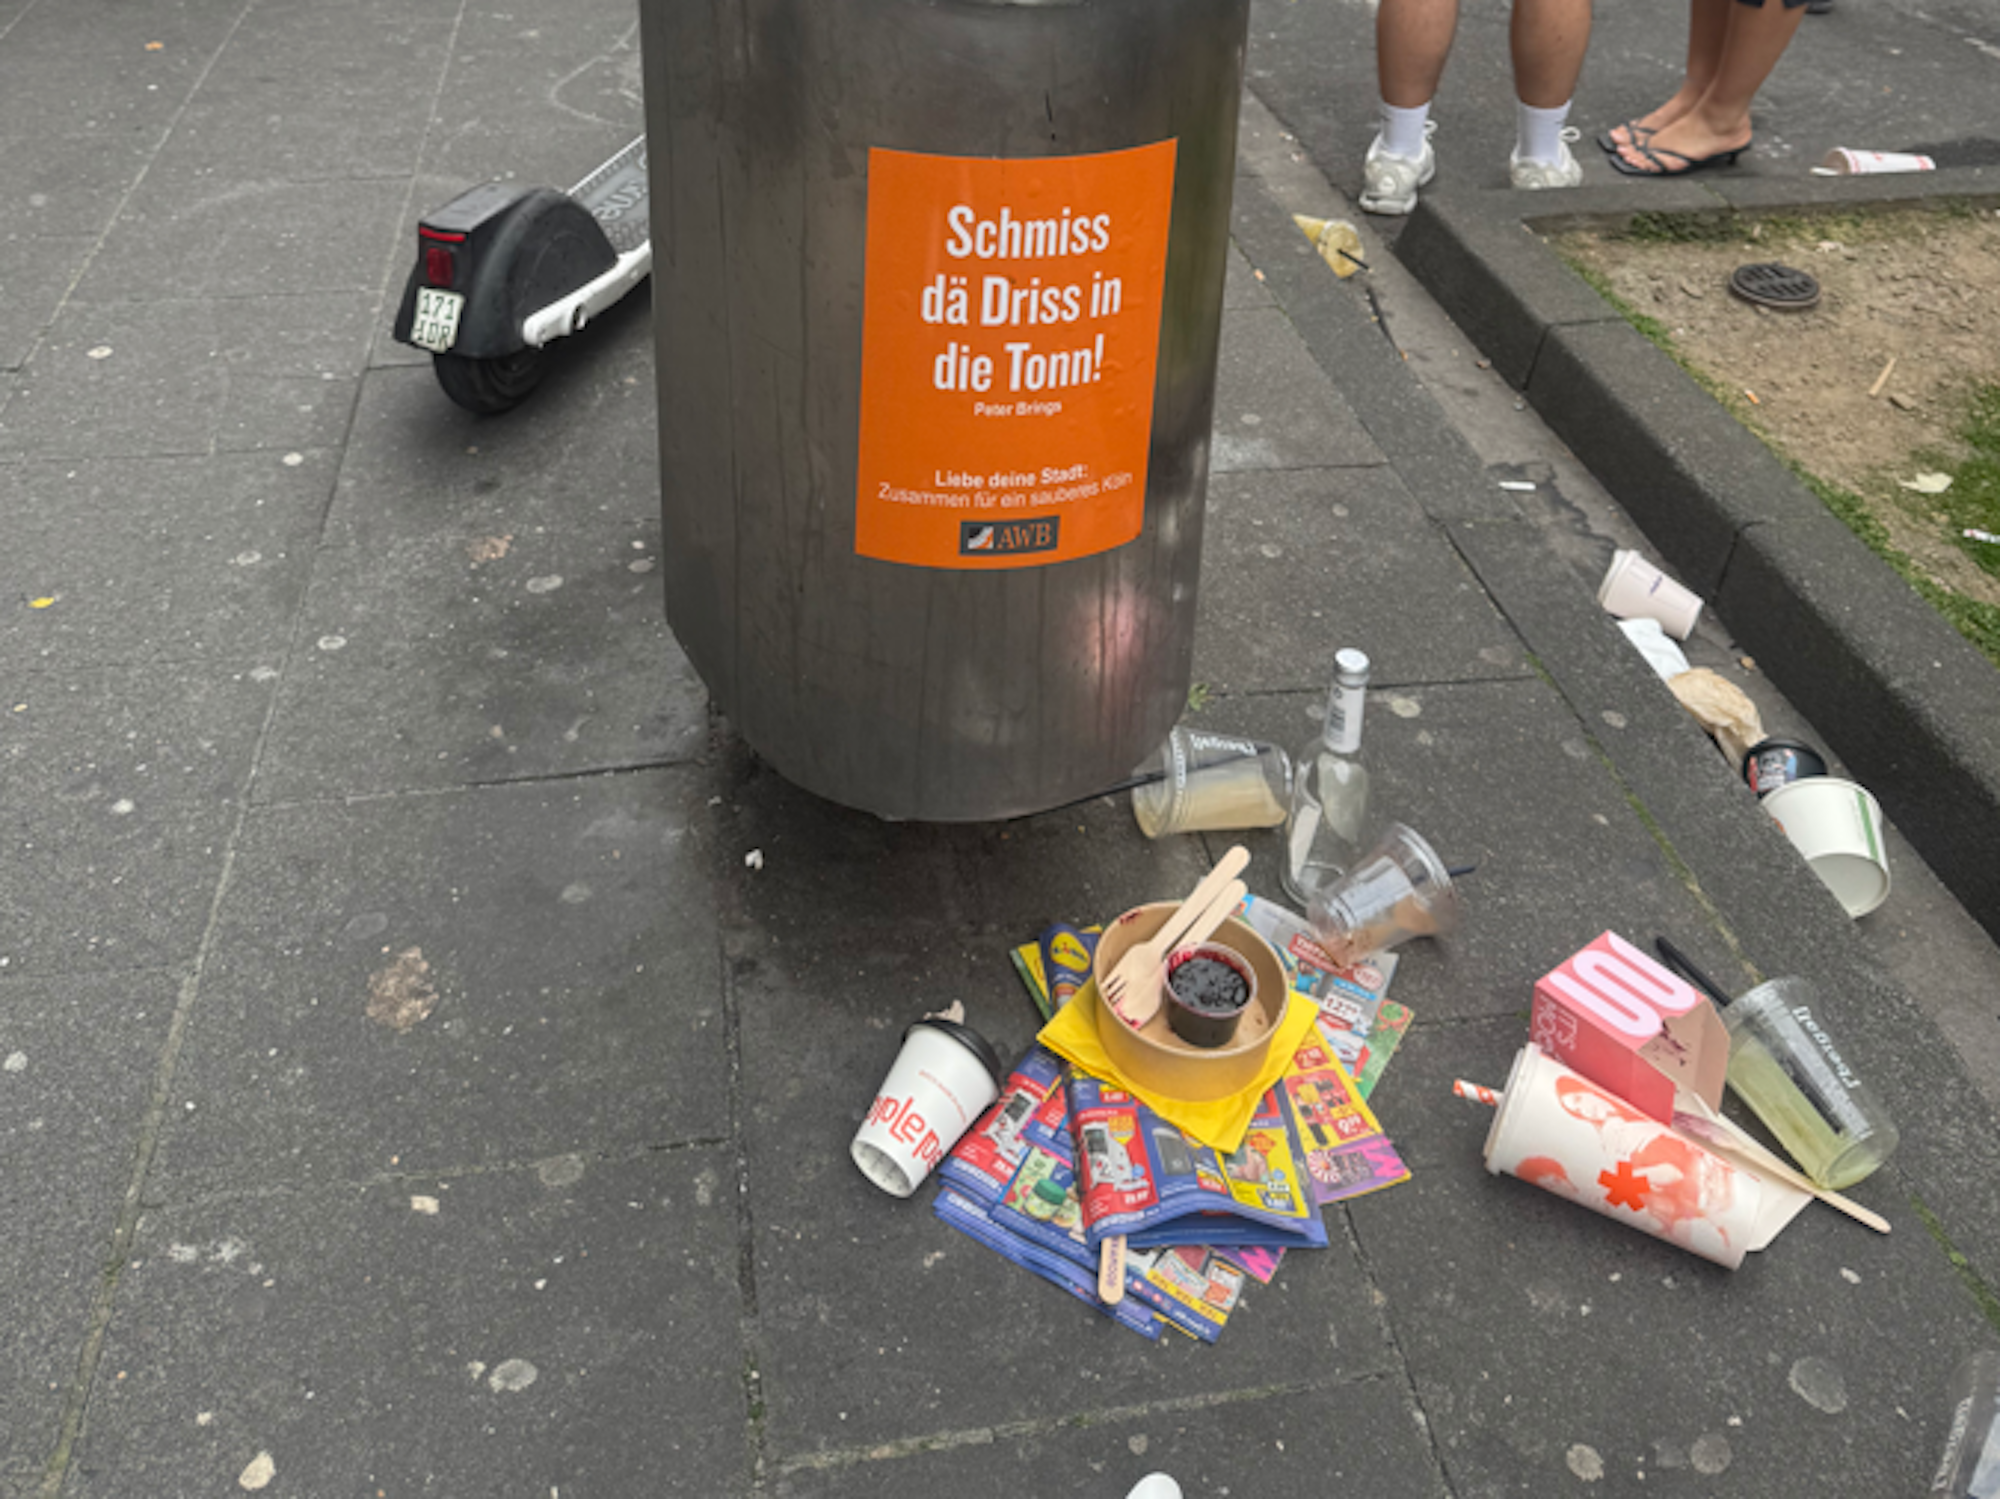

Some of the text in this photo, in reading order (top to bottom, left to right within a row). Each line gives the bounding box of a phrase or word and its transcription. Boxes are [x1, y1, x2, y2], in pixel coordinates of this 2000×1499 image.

[946, 205, 1110, 259] Schmiss
[420, 293, 454, 320] 171
[921, 271, 1122, 325] dä Driss in
[933, 333, 1105, 391] die Tonn!
[974, 400, 1062, 416] Peter Brings
[935, 464, 1088, 488] Liebe deine Stadt:
[878, 480, 970, 508] Zusammen
[974, 490, 997, 508] für
[1001, 491, 1026, 508] ein
[1030, 481, 1099, 506] sauberes
[997, 523, 1051, 549] AWB
